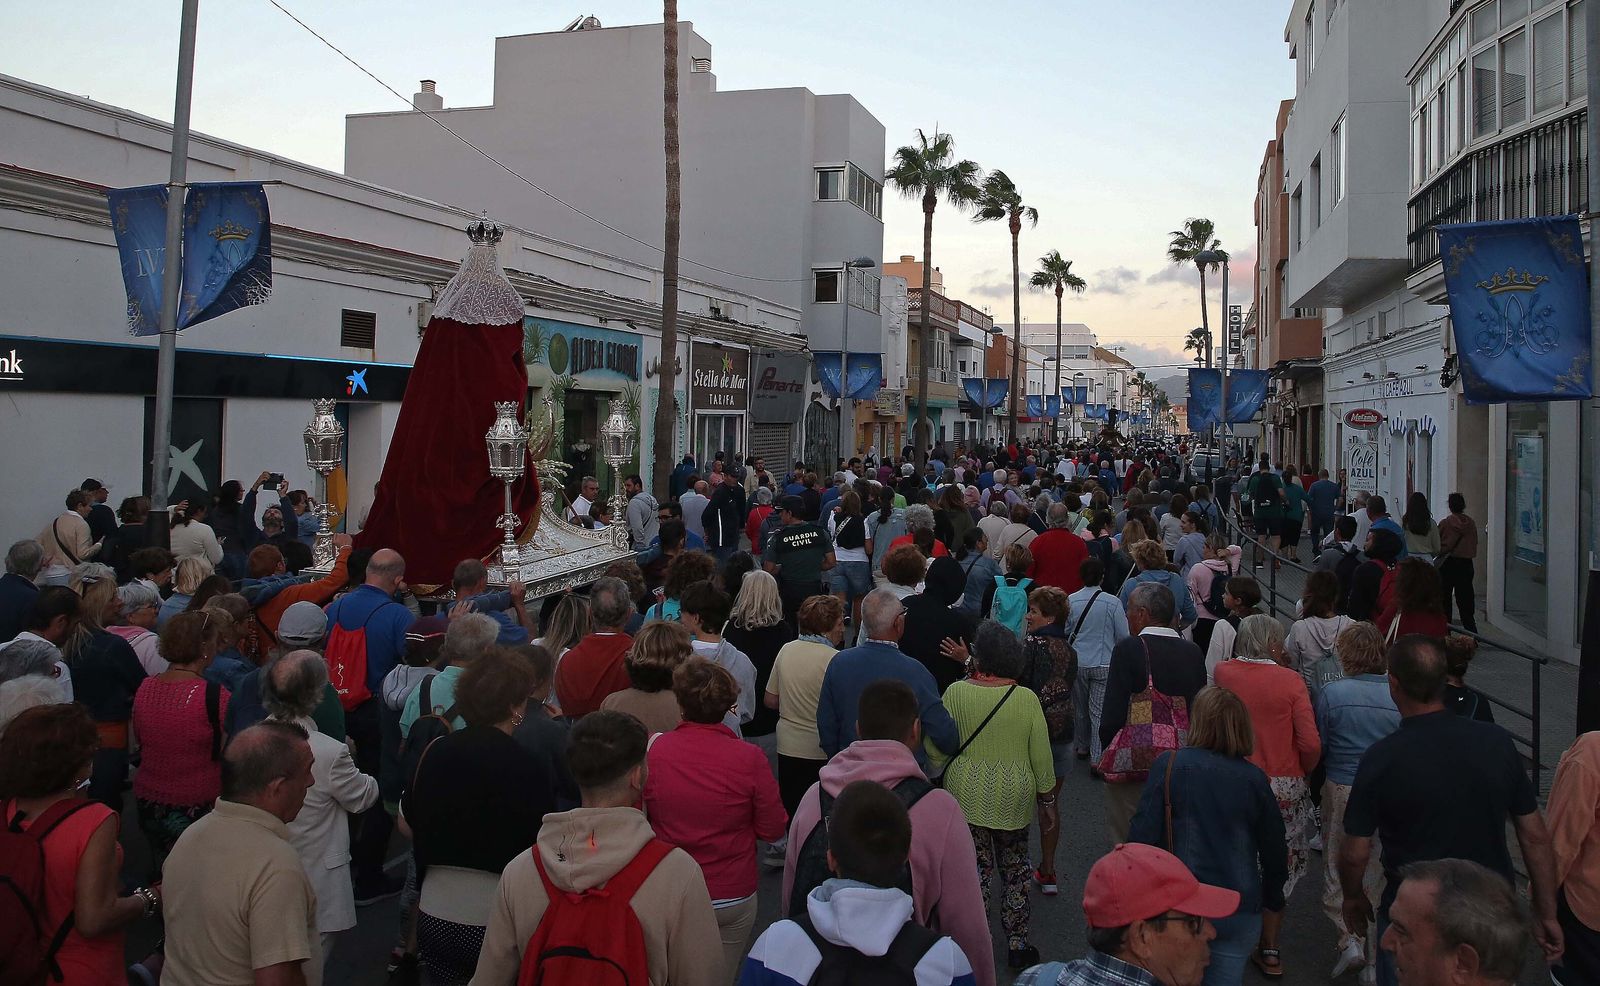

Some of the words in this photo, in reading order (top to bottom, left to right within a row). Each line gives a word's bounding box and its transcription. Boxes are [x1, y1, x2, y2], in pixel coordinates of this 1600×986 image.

[1230, 306, 1241, 349] HOTEL
[693, 368, 719, 388] Stella
[720, 371, 729, 389] de
[730, 374, 747, 390] Mar
[709, 393, 735, 406] TARIFA
[1351, 448, 1375, 468] Café
[1350, 468, 1375, 478] AZUL
[783, 532, 818, 543] GUARDIA
[792, 539, 812, 547] CIVIL
